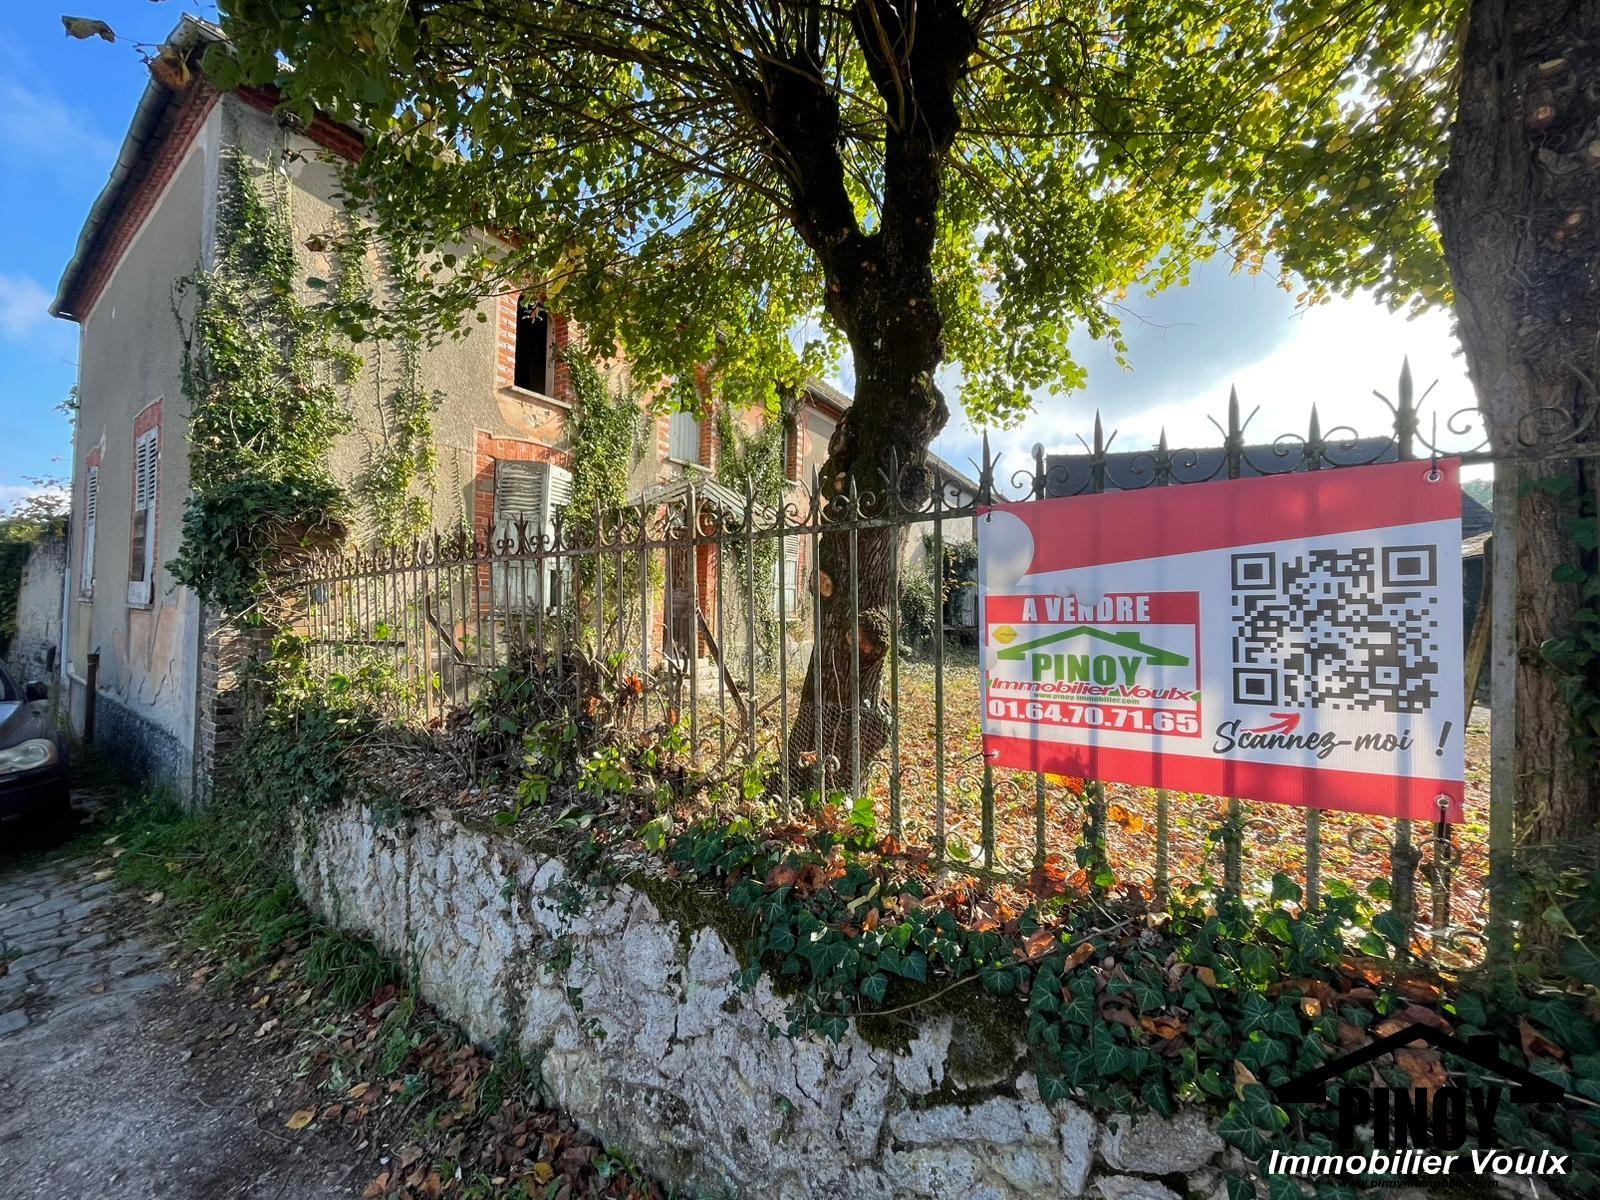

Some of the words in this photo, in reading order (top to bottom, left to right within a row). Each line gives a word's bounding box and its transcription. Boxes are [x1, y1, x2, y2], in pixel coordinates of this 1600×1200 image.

[1022, 598, 1038, 622] A
[1045, 596, 1151, 622] VENDRE
[1032, 653, 1142, 686] PINOY
[990, 677, 1116, 696] Immobilier
[1118, 684, 1193, 701] Voulx
[988, 699, 1199, 734] 01.64.70.71.65
[1213, 719, 1414, 760] Scannez-moi
